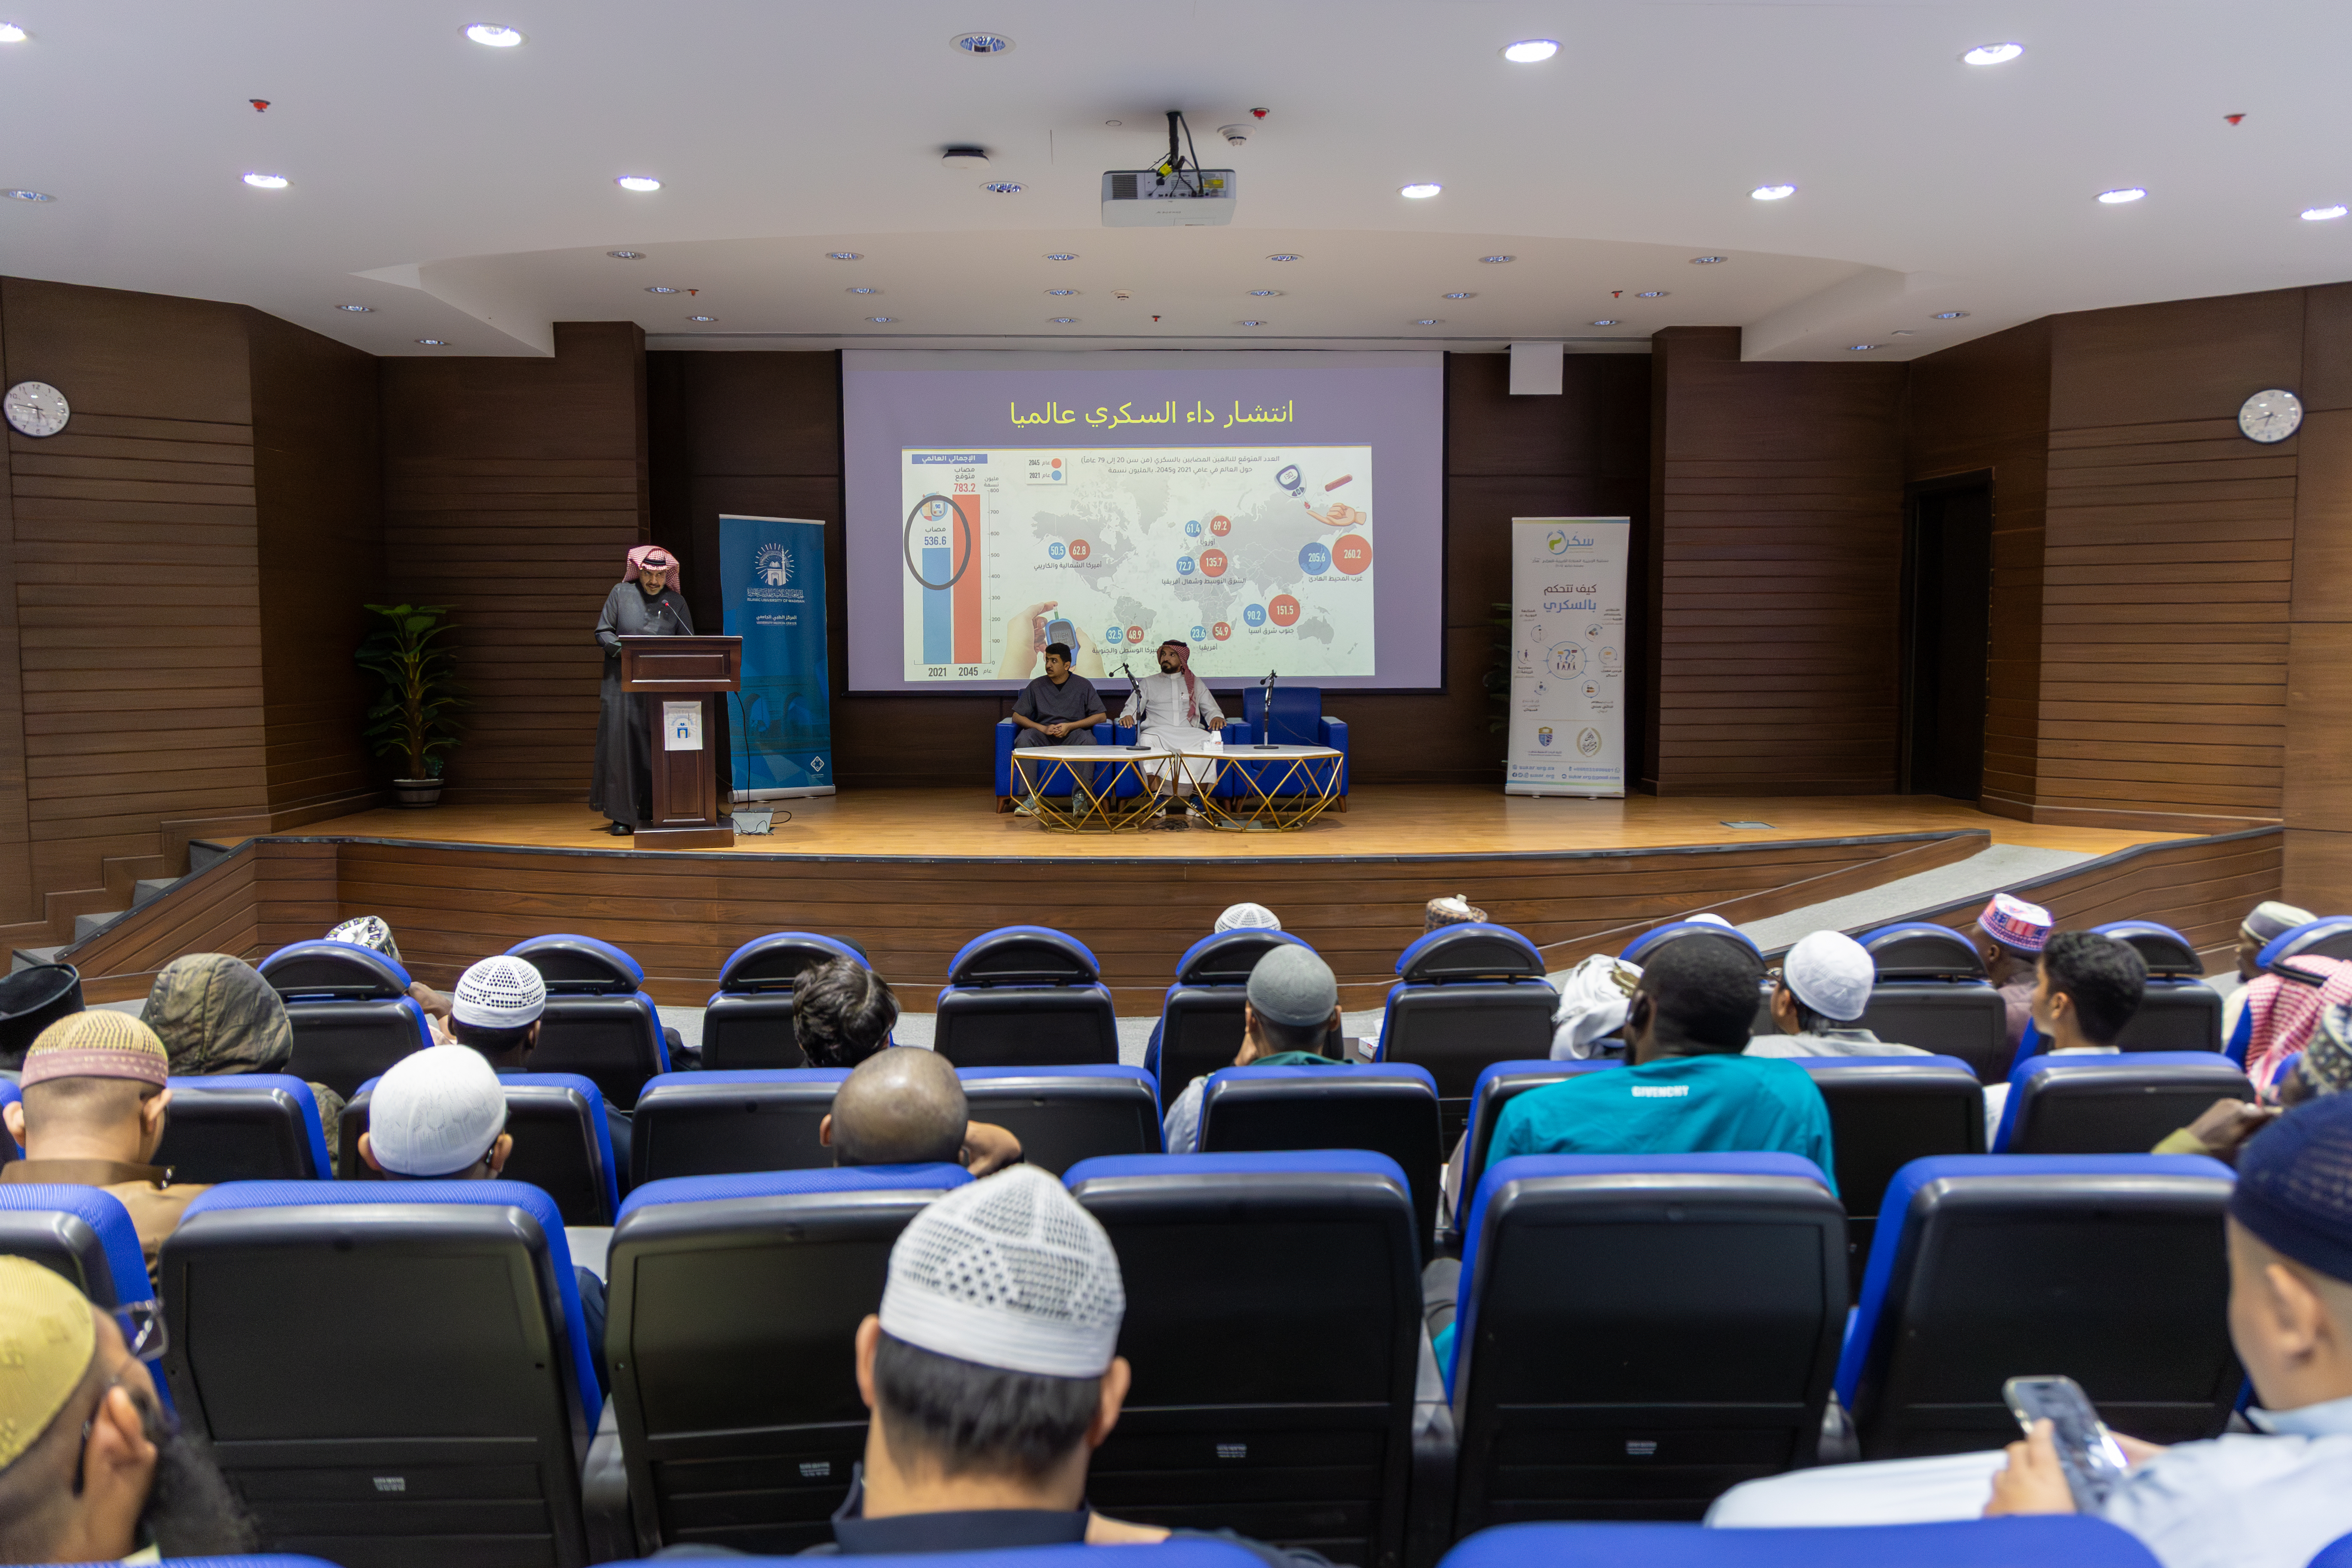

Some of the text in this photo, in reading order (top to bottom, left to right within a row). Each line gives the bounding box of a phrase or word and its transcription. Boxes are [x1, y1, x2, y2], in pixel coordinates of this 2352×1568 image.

[1011, 400, 1293, 429] انتشار داء السكري عالميا
[922, 455, 946, 463] العالمي
[1155, 456, 1180, 465] بالسكري
[1238, 456, 1262, 464] المتوقع
[955, 473, 975, 481] متوقع
[954, 483, 976, 492] 783.2
[1186, 521, 1227, 533] 61.4 69.2
[924, 536, 946, 545] 536.6
[1050, 545, 1086, 555] 50.5 62.8
[1308, 549, 1361, 562] 205.6 260.2
[1034, 563, 1058, 571] والكاريبي
[1086, 561, 1102, 570] أميركا
[1179, 557, 1222, 571] 72.7 135.7
[1544, 583, 1597, 596] كيف تتحكم
[1544, 599, 1596, 613] بالسكري
[1247, 605, 1293, 620] 90.2 151.5
[1108, 630, 1142, 640] 32.5 48.9
[1192, 627, 1228, 638] 23.6 54.9
[1199, 643, 1217, 651] أفريقيا
[928, 668, 946, 677] 2021
[959, 667, 978, 676] 2045
[1631, 1085, 1689, 1097] GIVENCHY
